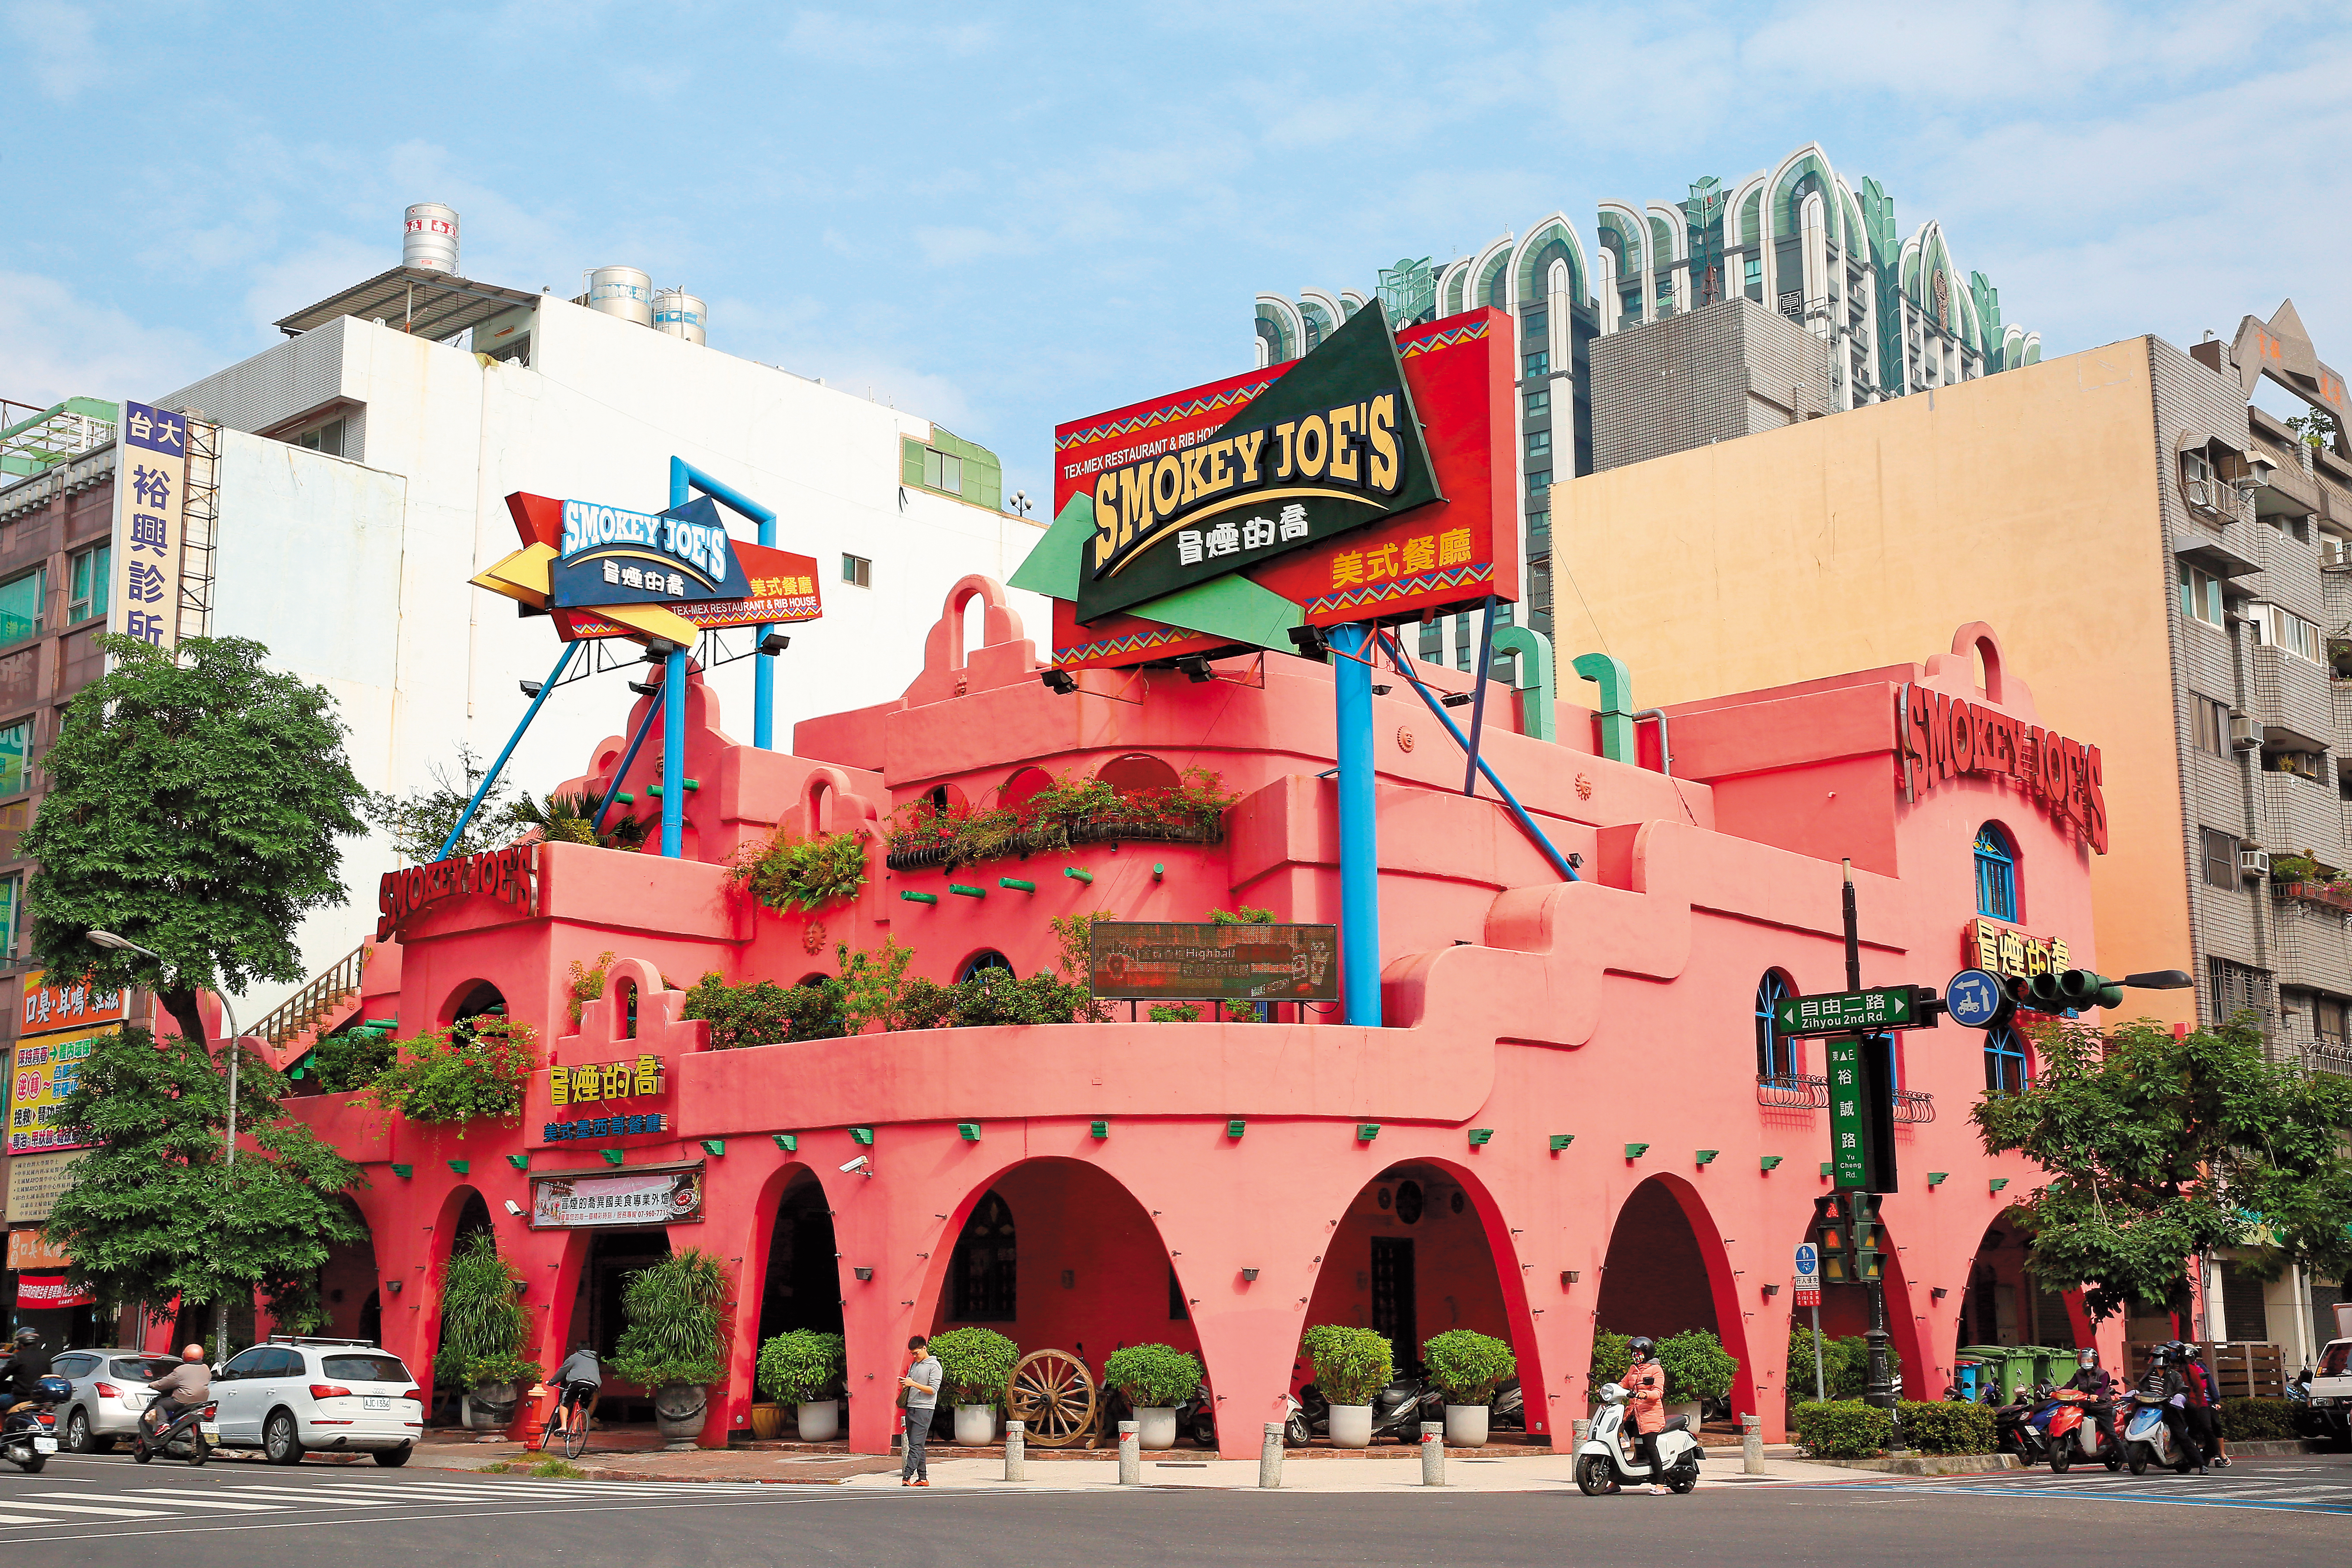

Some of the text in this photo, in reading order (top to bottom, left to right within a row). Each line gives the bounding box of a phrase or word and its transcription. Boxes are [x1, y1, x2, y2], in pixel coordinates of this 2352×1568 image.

[433, 221, 455, 238] 南亞
[128, 410, 183, 448] 台大
[1064, 423, 1226, 480] TEX-MEX RESTAURANT & RIB HOU
[1094, 393, 1399, 571] SMOKEY JOE'S
[128, 464, 171, 647] 裕興診所
[562, 499, 726, 584] SMOKEY JOE'S
[1332, 527, 1473, 590] 美式餐廳
[750, 575, 814, 597] 美式餐廳
[671, 596, 817, 616] TEX-MEX RESTAURANT & RIB HOUSE
[1900, 682, 2108, 855] SMOKEY JOE'S
[376, 845, 538, 943] SMOKEY JOE'S
[1800, 994, 1885, 1017] 自由二路
[1801, 1011, 1887, 1029] Zihyou 2nd Rd.
[1832, 1051, 1839, 1061] 東
[1848, 1049, 1855, 1061] E
[1837, 1068, 1856, 1149] 裕誠路
[543, 1113, 661, 1143] 美式墨西哥餐廳
[638, 1209, 669, 1218] 07-960-7715
